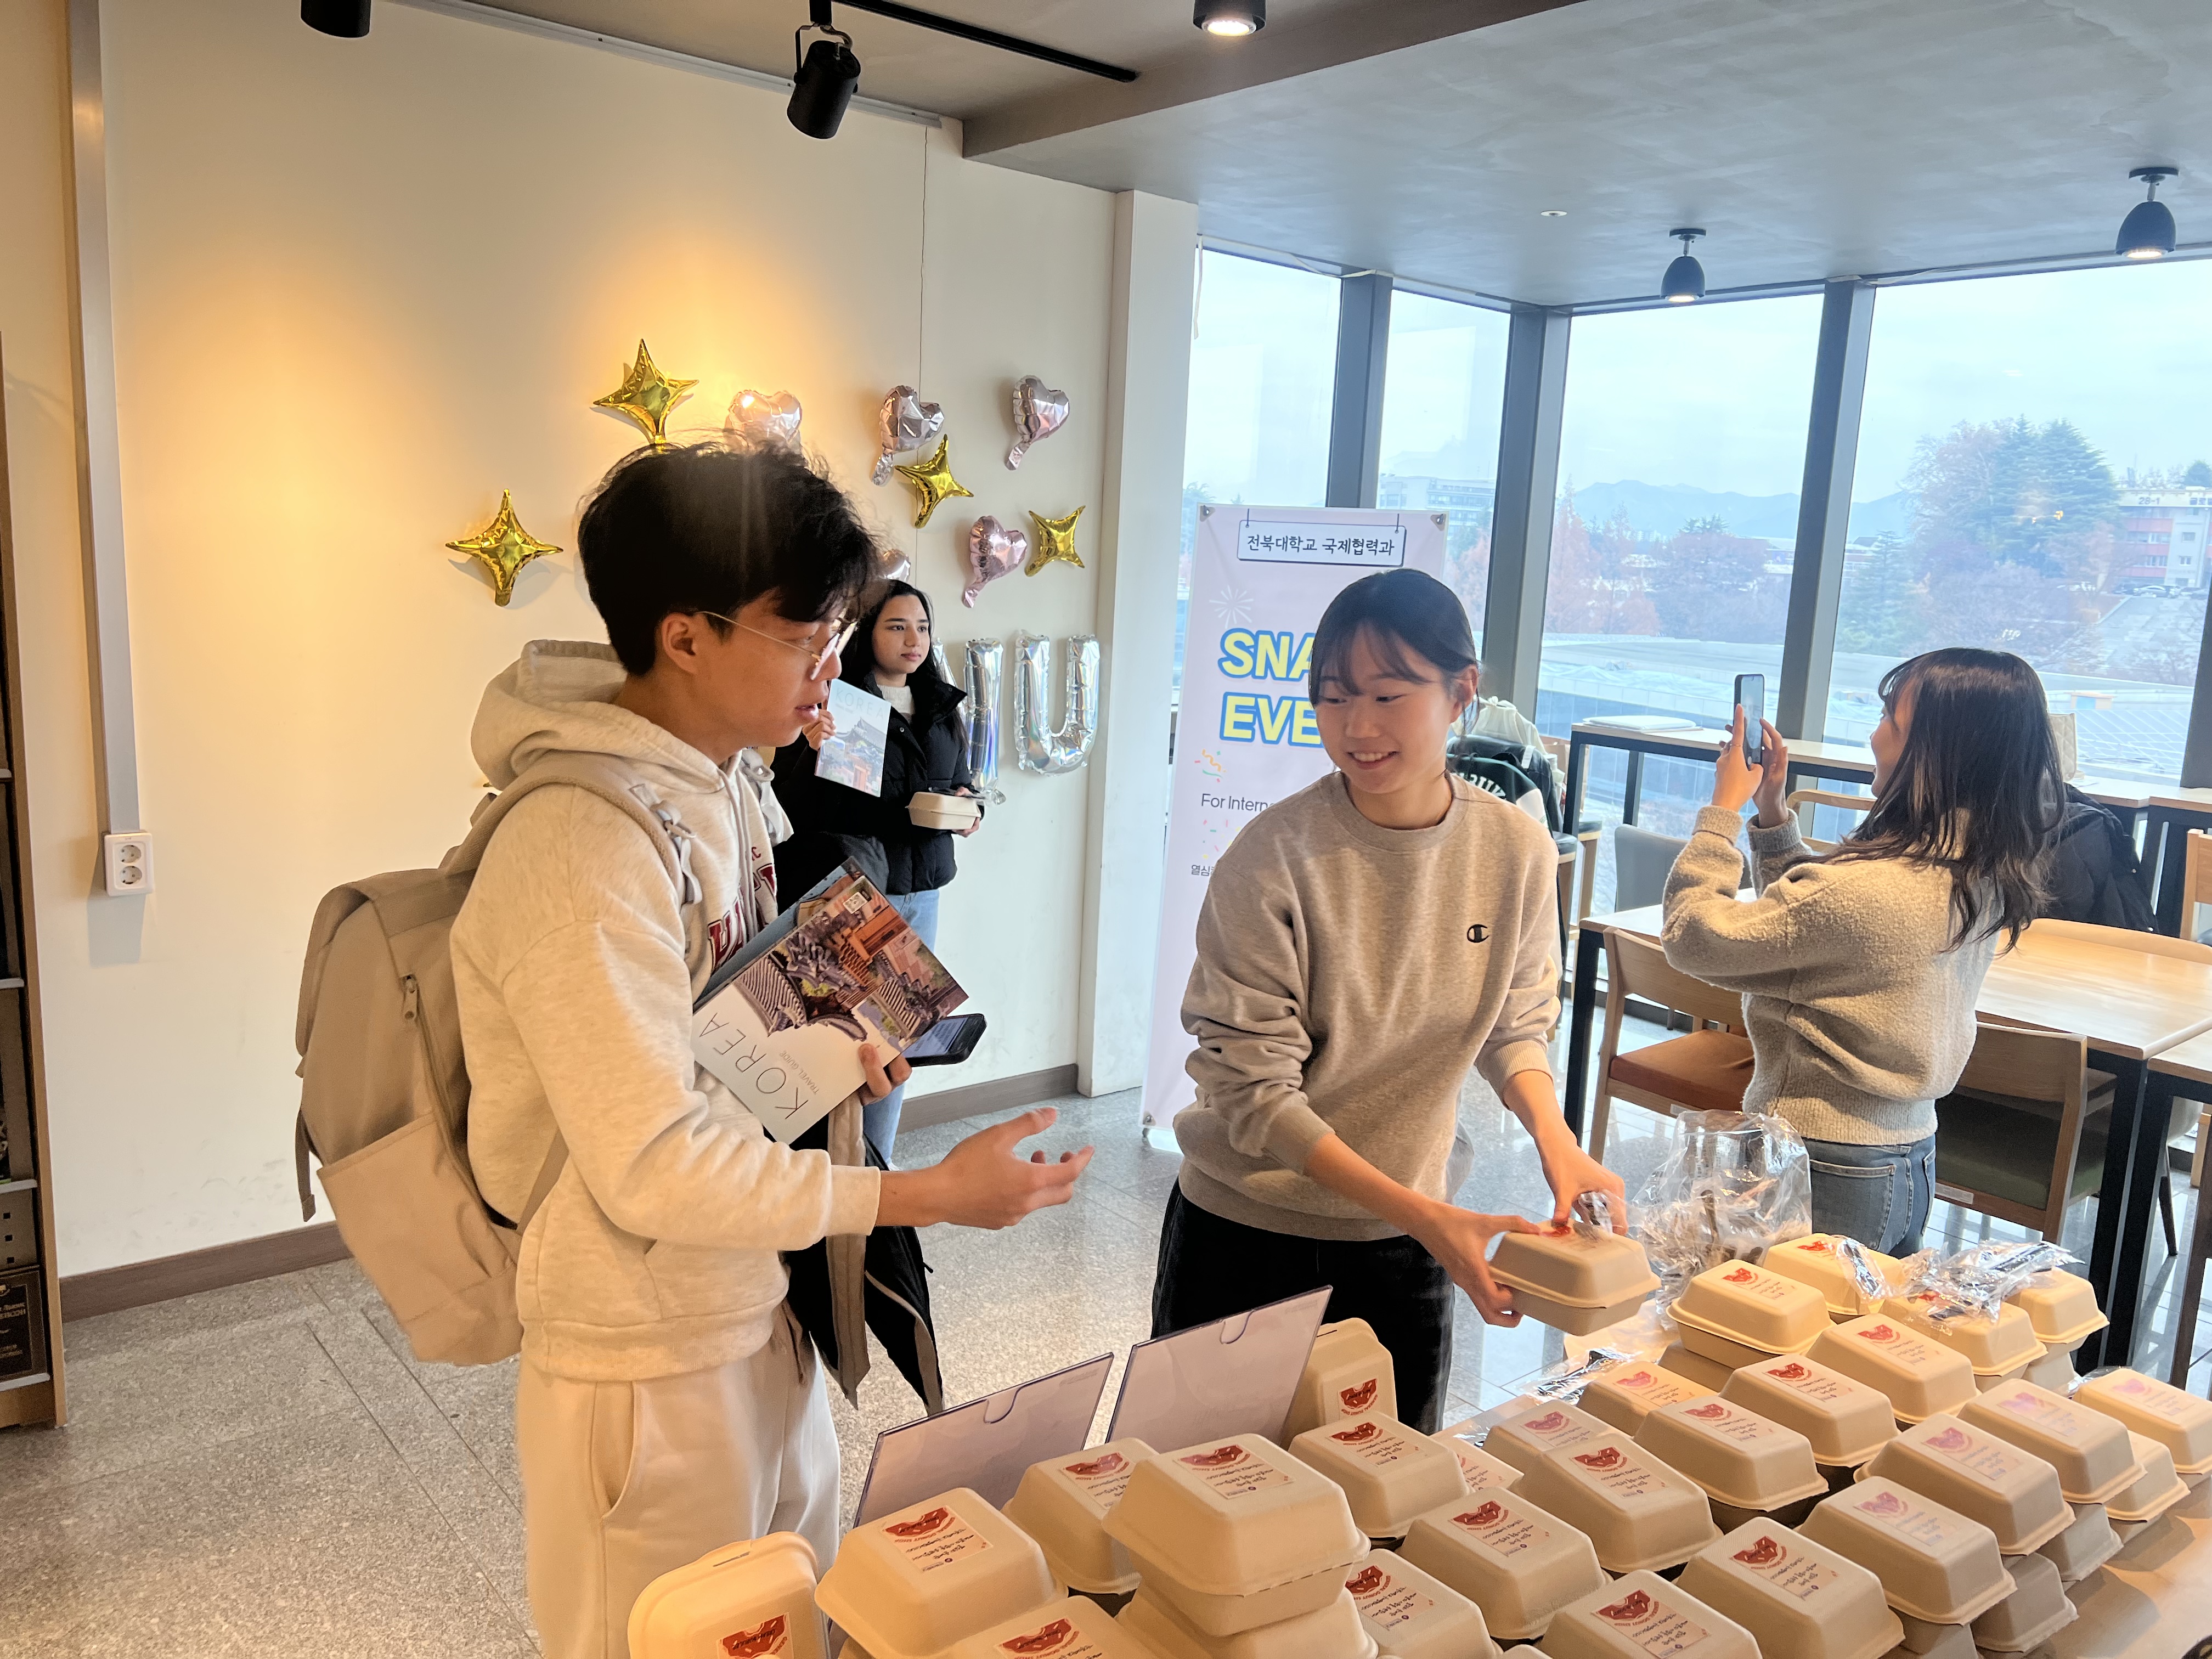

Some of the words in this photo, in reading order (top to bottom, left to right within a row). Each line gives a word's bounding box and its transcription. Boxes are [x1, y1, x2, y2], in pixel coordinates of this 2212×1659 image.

[1247, 534, 1318, 552] 전북대학교
[1322, 538, 1395, 556] 국제협력과
[835, 689, 884, 720] KOREA
[1201, 793, 1226, 809] For
[1228, 795, 1276, 812] Intern
[1191, 864, 1215, 877] 열심
[699, 1012, 809, 1120] KOREA
[779, 1050, 799, 1070] GUIDE
[798, 1069, 820, 1095] TRAVEL
